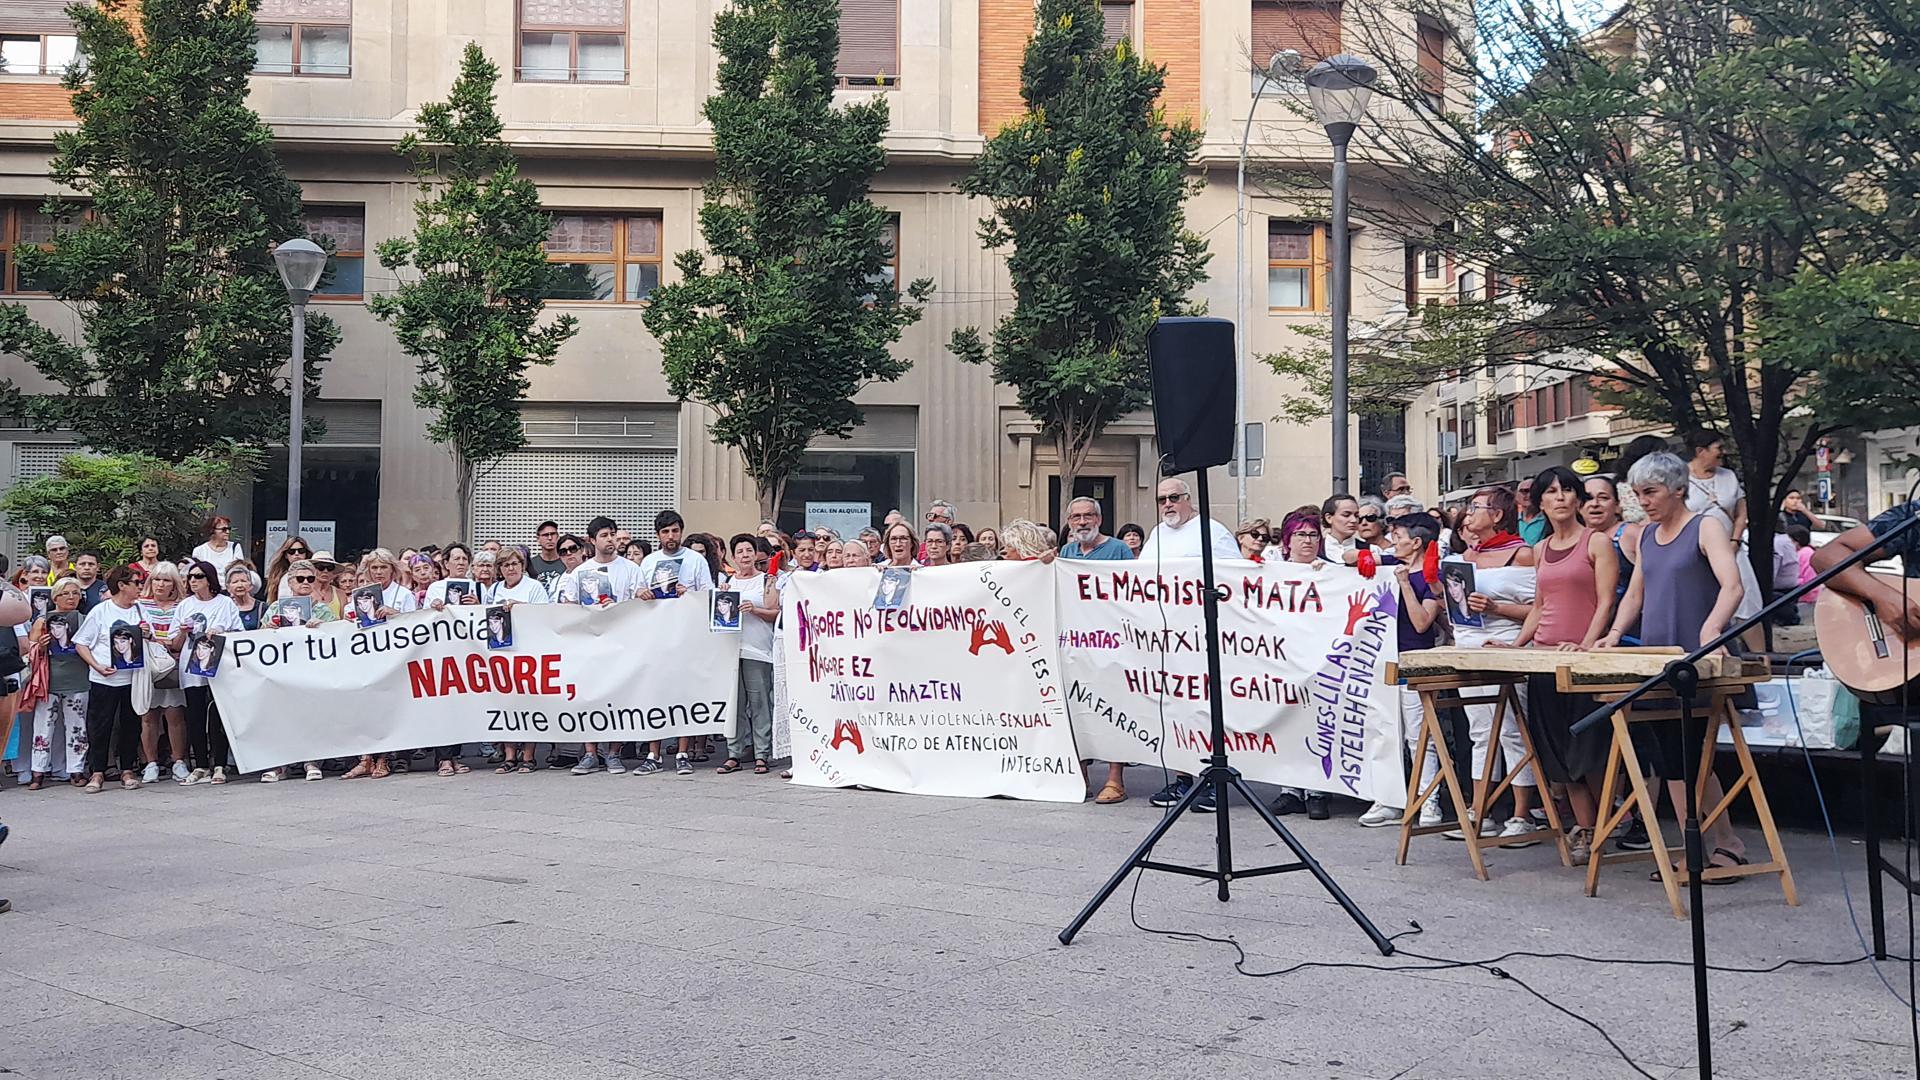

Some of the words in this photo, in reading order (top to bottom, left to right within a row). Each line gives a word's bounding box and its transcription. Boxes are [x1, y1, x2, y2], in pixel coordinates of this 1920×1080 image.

[1077, 574, 1109, 601] EL
[1243, 576, 1323, 613] MATA
[1013, 607, 1029, 627] EL
[233, 640, 294, 668] Por
[304, 634, 338, 661] tu
[350, 612, 488, 655] ausencia
[407, 653, 576, 700] NAGORE,
[809, 644, 845, 682] NAGORE
[852, 655, 875, 678] EZ
[486, 710, 549, 731] zure
[558, 701, 727, 733] oroimenez
[1069, 680, 1161, 753] NAFARROA
[923, 736, 940, 751] DE
